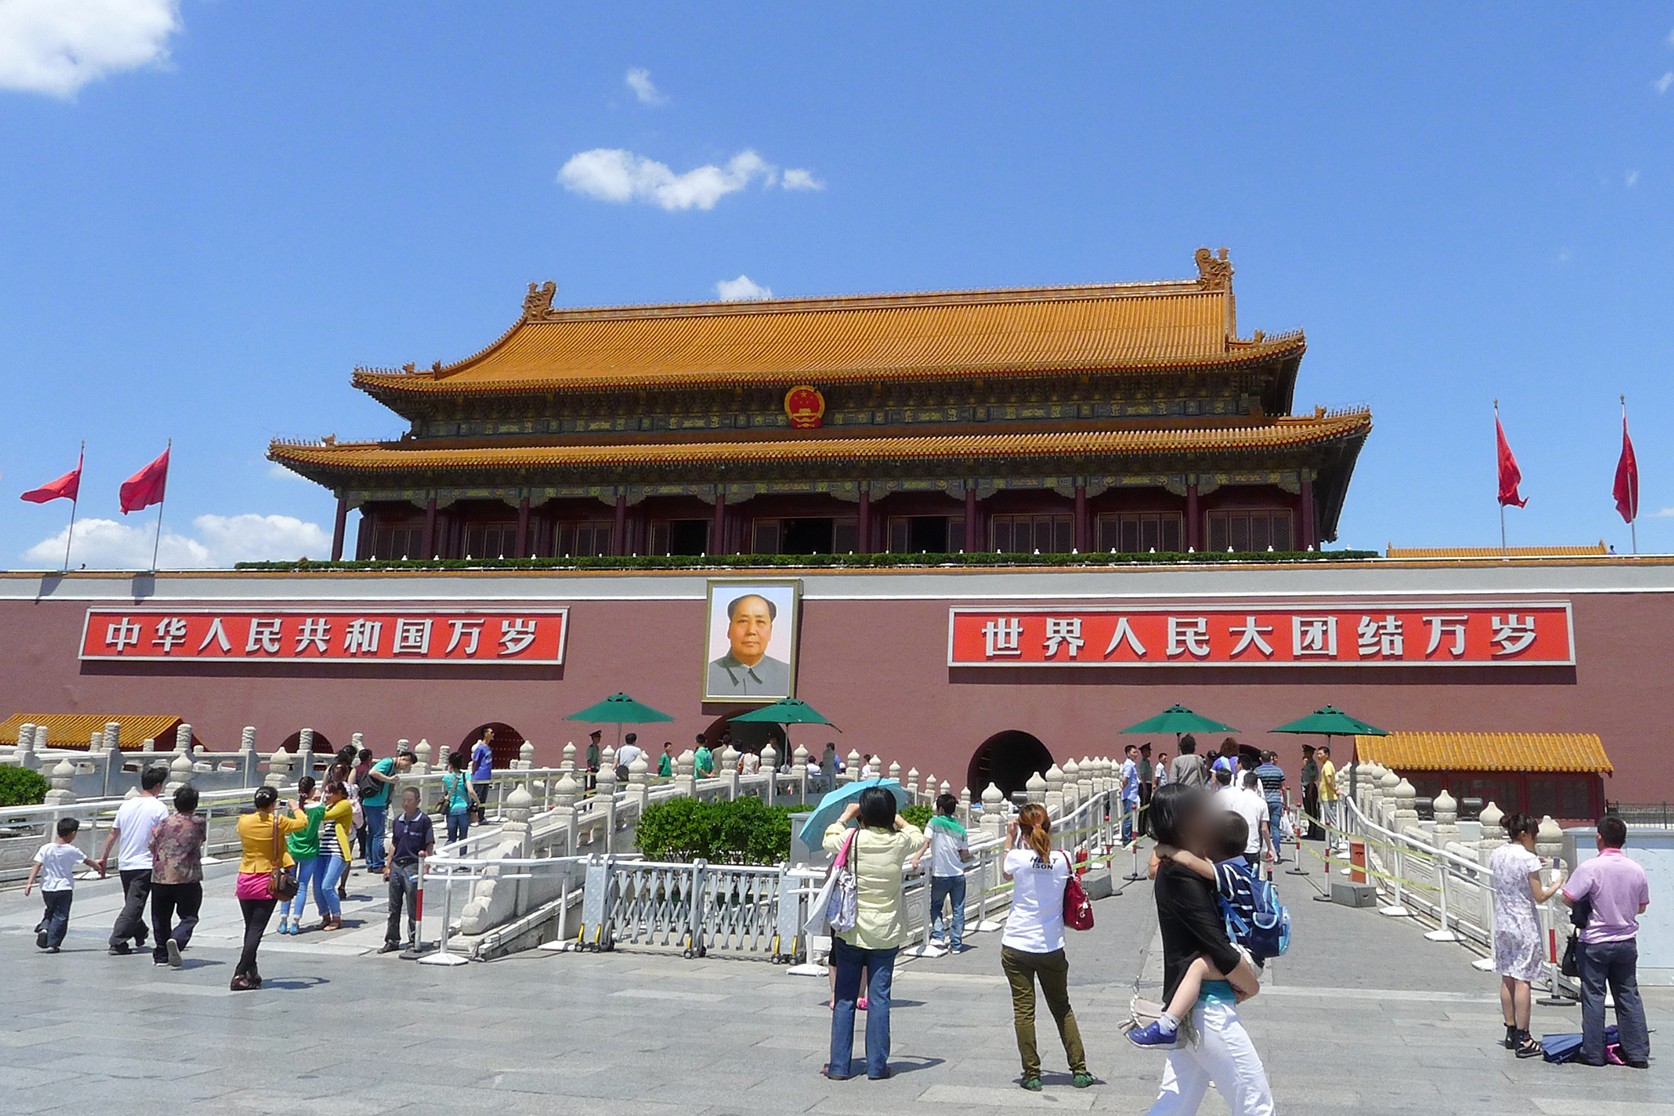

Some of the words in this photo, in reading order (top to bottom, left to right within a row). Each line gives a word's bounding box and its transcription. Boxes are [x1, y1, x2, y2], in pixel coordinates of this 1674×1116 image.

[105, 617, 537, 655] 中华人民共和国万岁
[981, 613, 1537, 657] 世界人民大团结万岁
